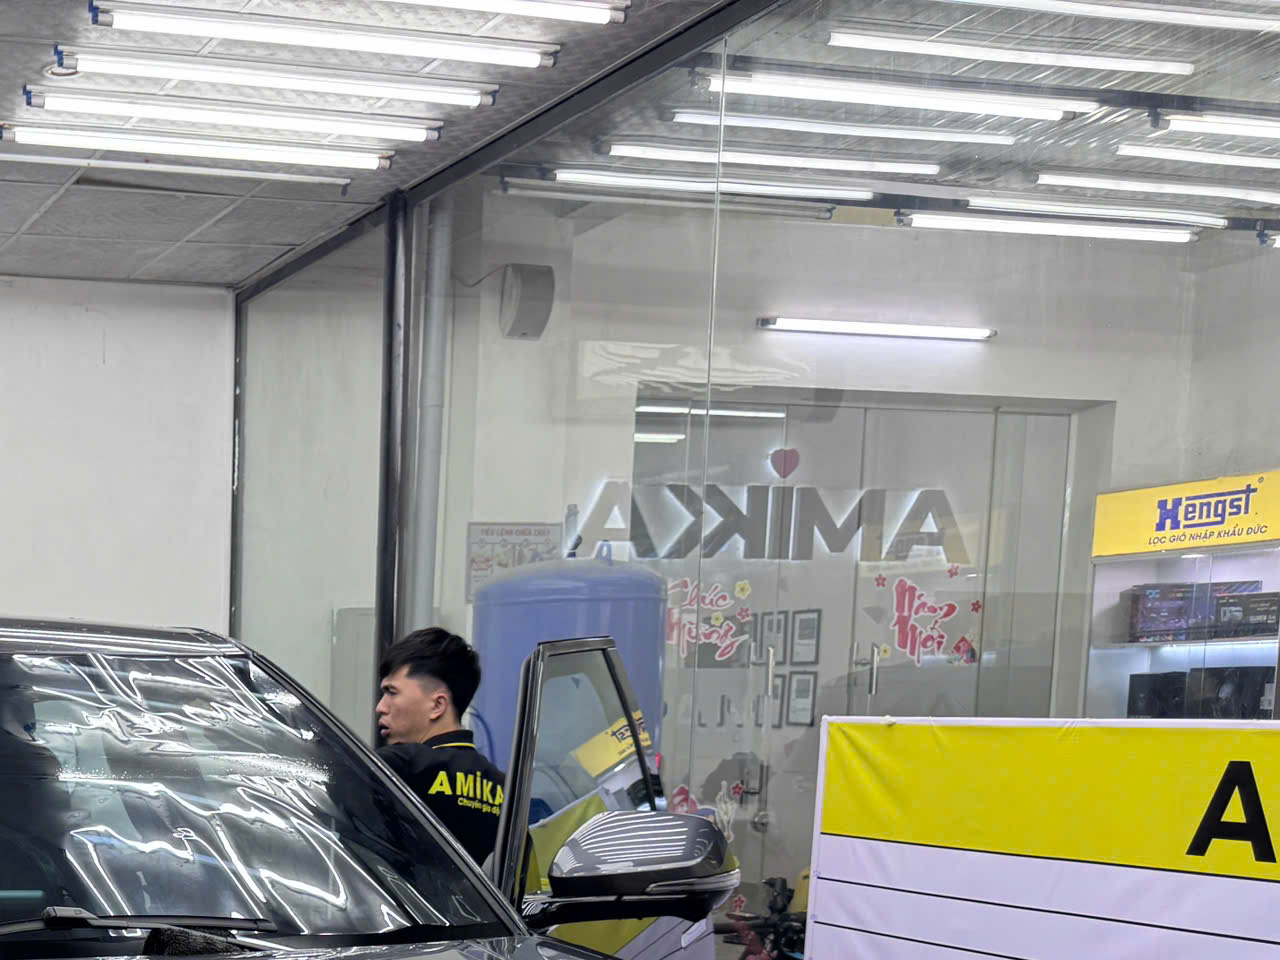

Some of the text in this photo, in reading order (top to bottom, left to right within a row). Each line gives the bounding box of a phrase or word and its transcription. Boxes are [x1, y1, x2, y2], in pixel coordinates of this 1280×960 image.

[1155, 484, 1258, 532] Hengst
[1189, 529, 1215, 542] NHẬP
[1185, 760, 1277, 864] A
